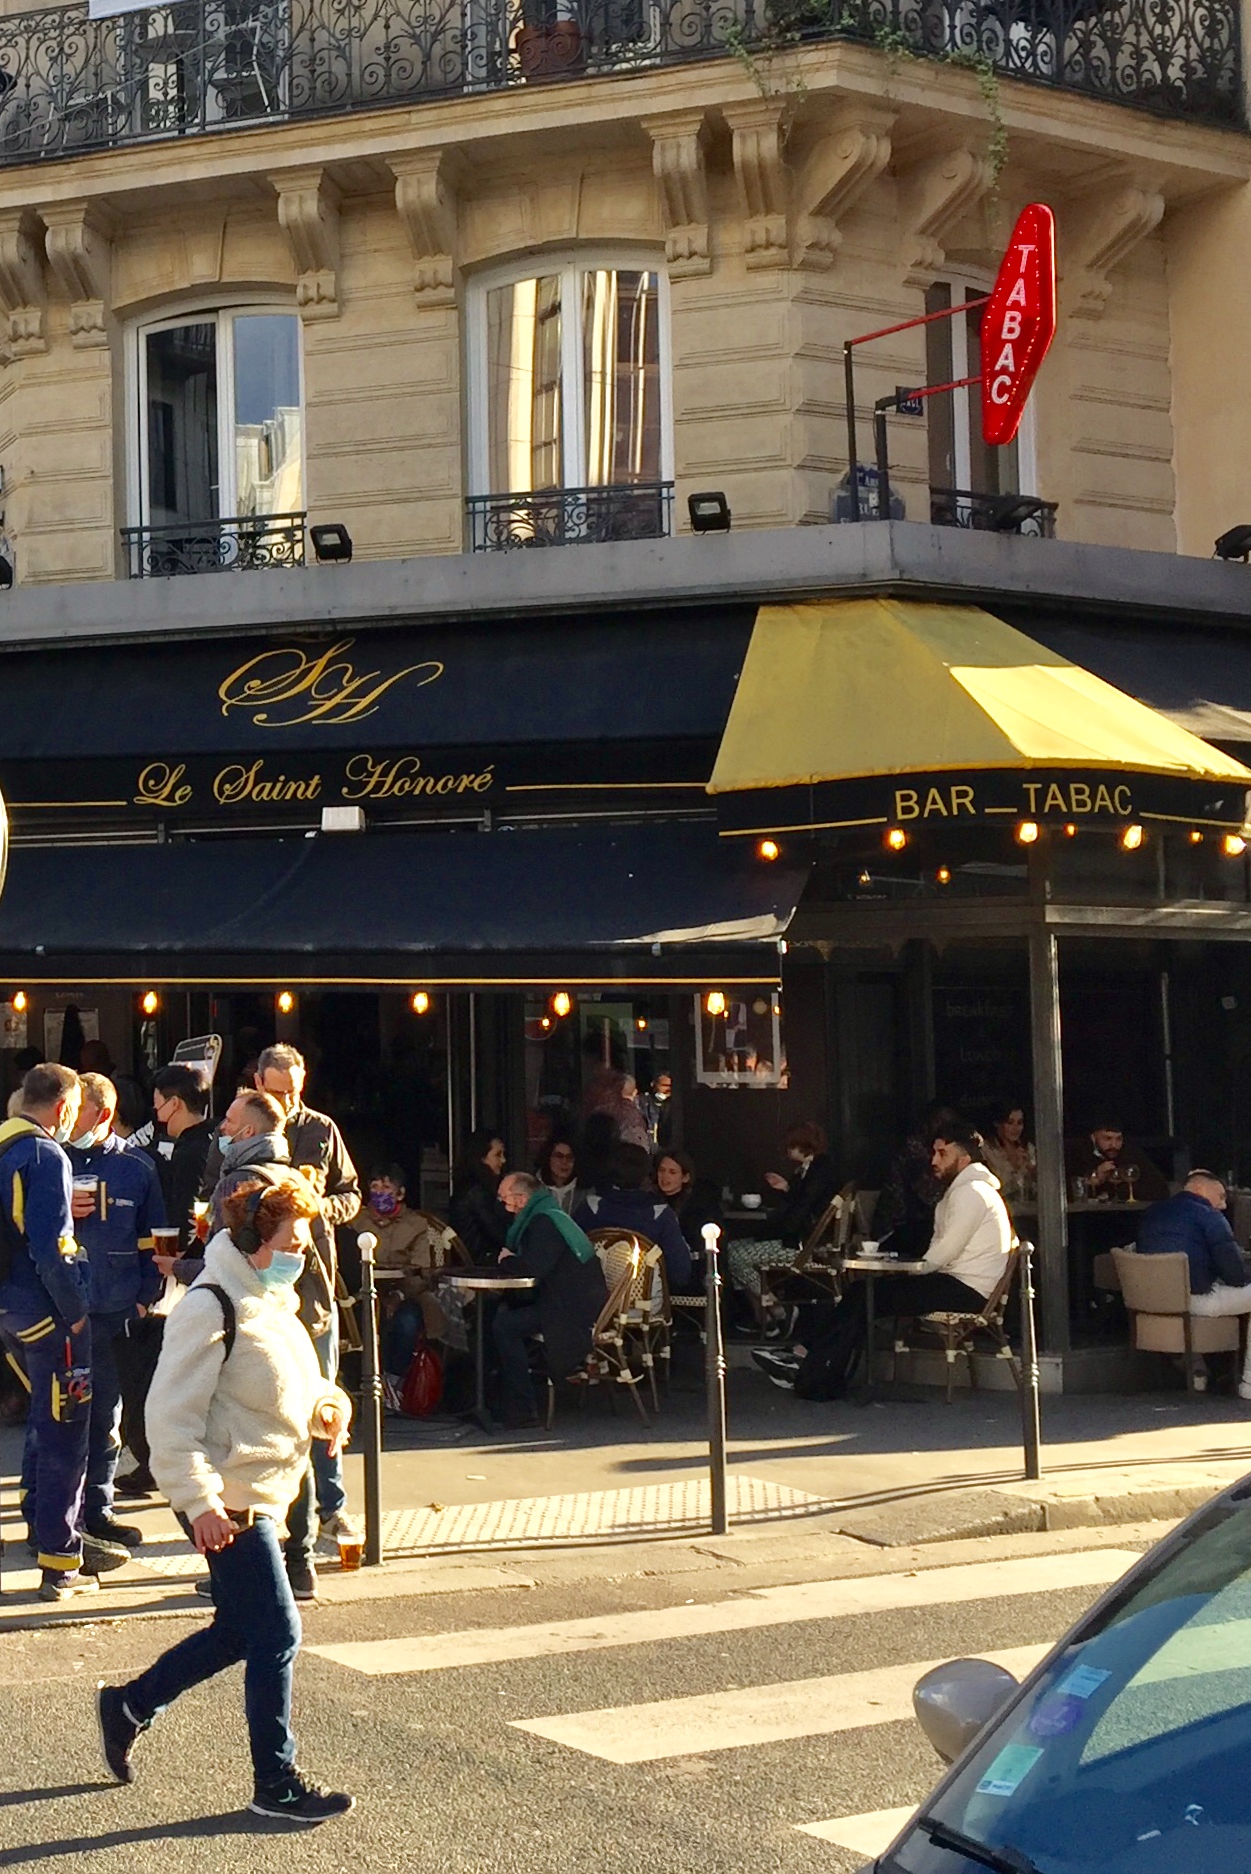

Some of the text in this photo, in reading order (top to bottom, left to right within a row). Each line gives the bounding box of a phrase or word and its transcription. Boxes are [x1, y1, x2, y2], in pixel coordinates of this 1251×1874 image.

[991, 244, 1036, 405] TABAC
[134, 754, 496, 807] Le Saint Honoré
[894, 782, 1133, 820] BAR TABAC
